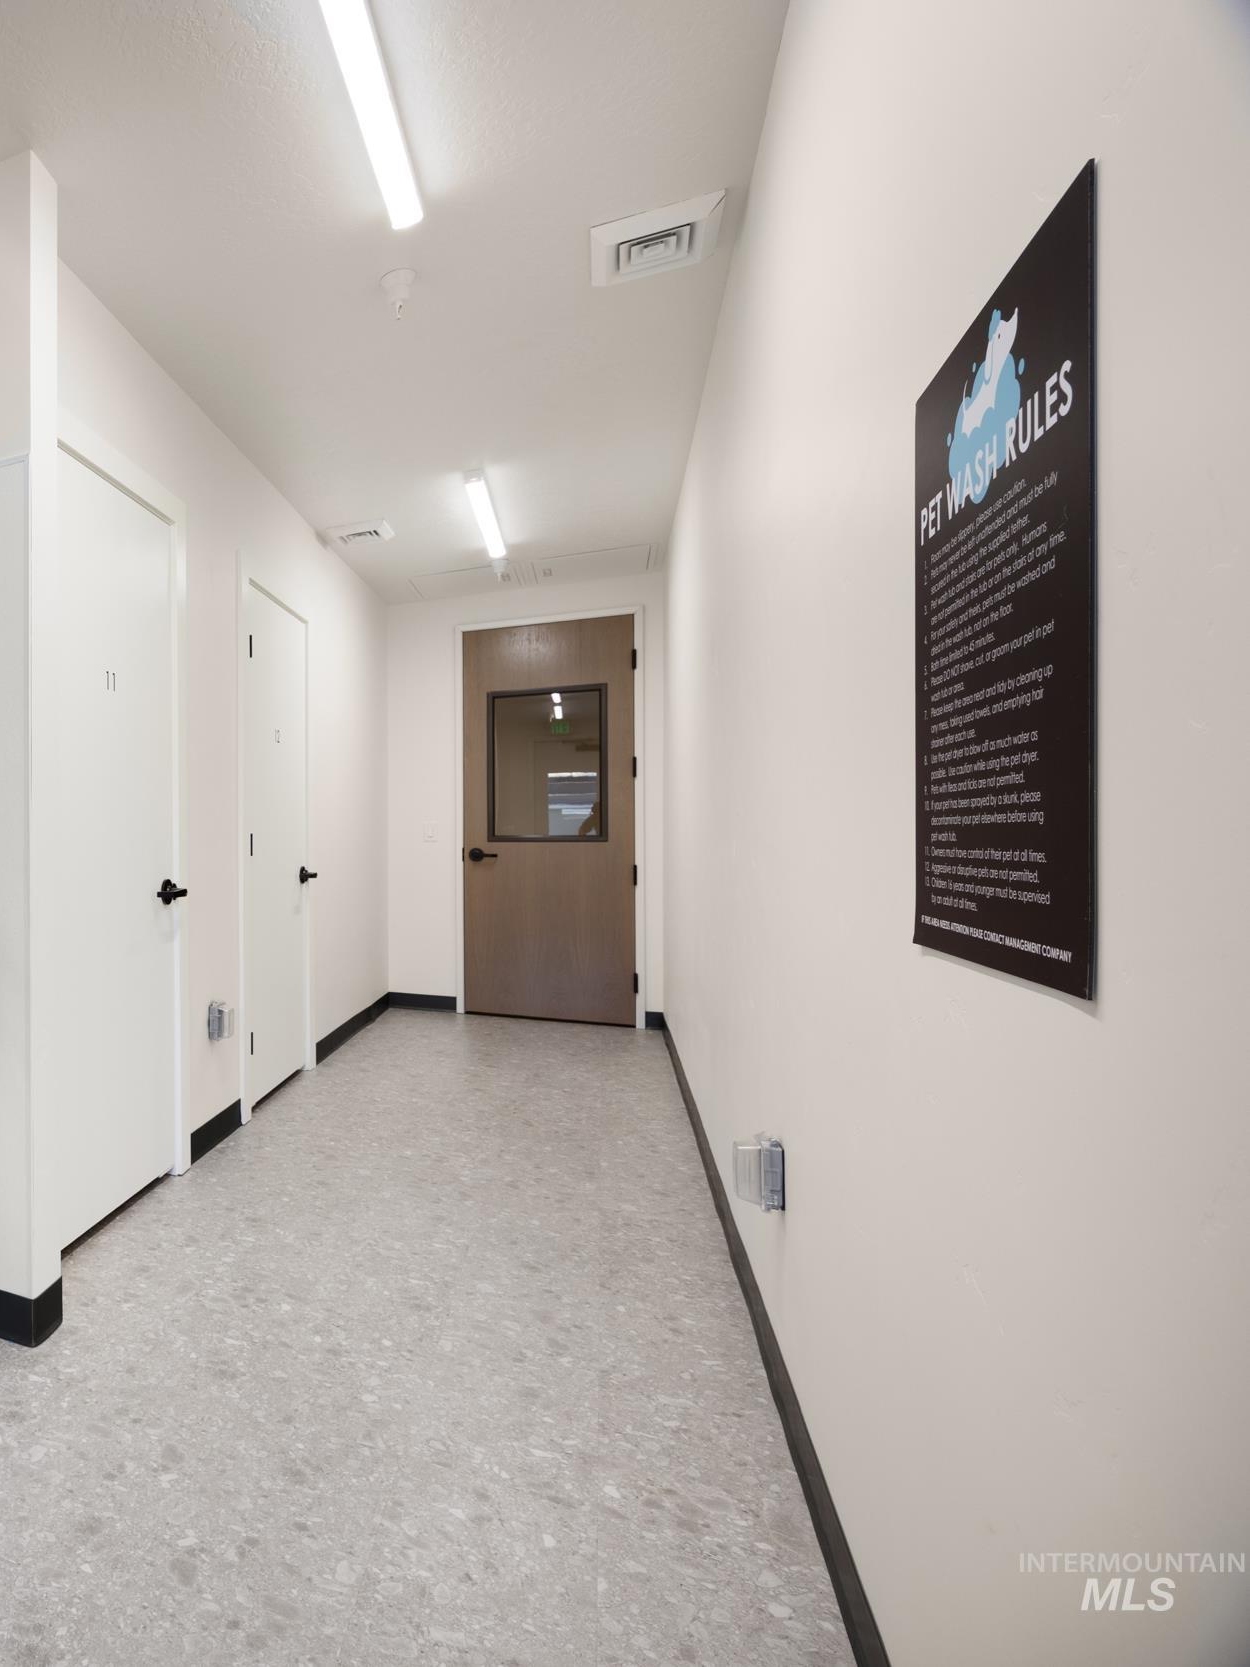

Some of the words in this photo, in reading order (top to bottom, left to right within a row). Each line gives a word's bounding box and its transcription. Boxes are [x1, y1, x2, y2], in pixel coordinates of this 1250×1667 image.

[921, 490, 943, 546] PET
[946, 434, 998, 520] WASH
[1005, 359, 1073, 468] RULES
[939, 919, 949, 930] NEEDS
[950, 922, 969, 935] ATTENTION
[970, 927, 983, 939] PLEASE
[984, 930, 1004, 945] CONTACT
[1005, 935, 1040, 955] MANAGEMENT
[1042, 945, 1071, 963] COMPANY
